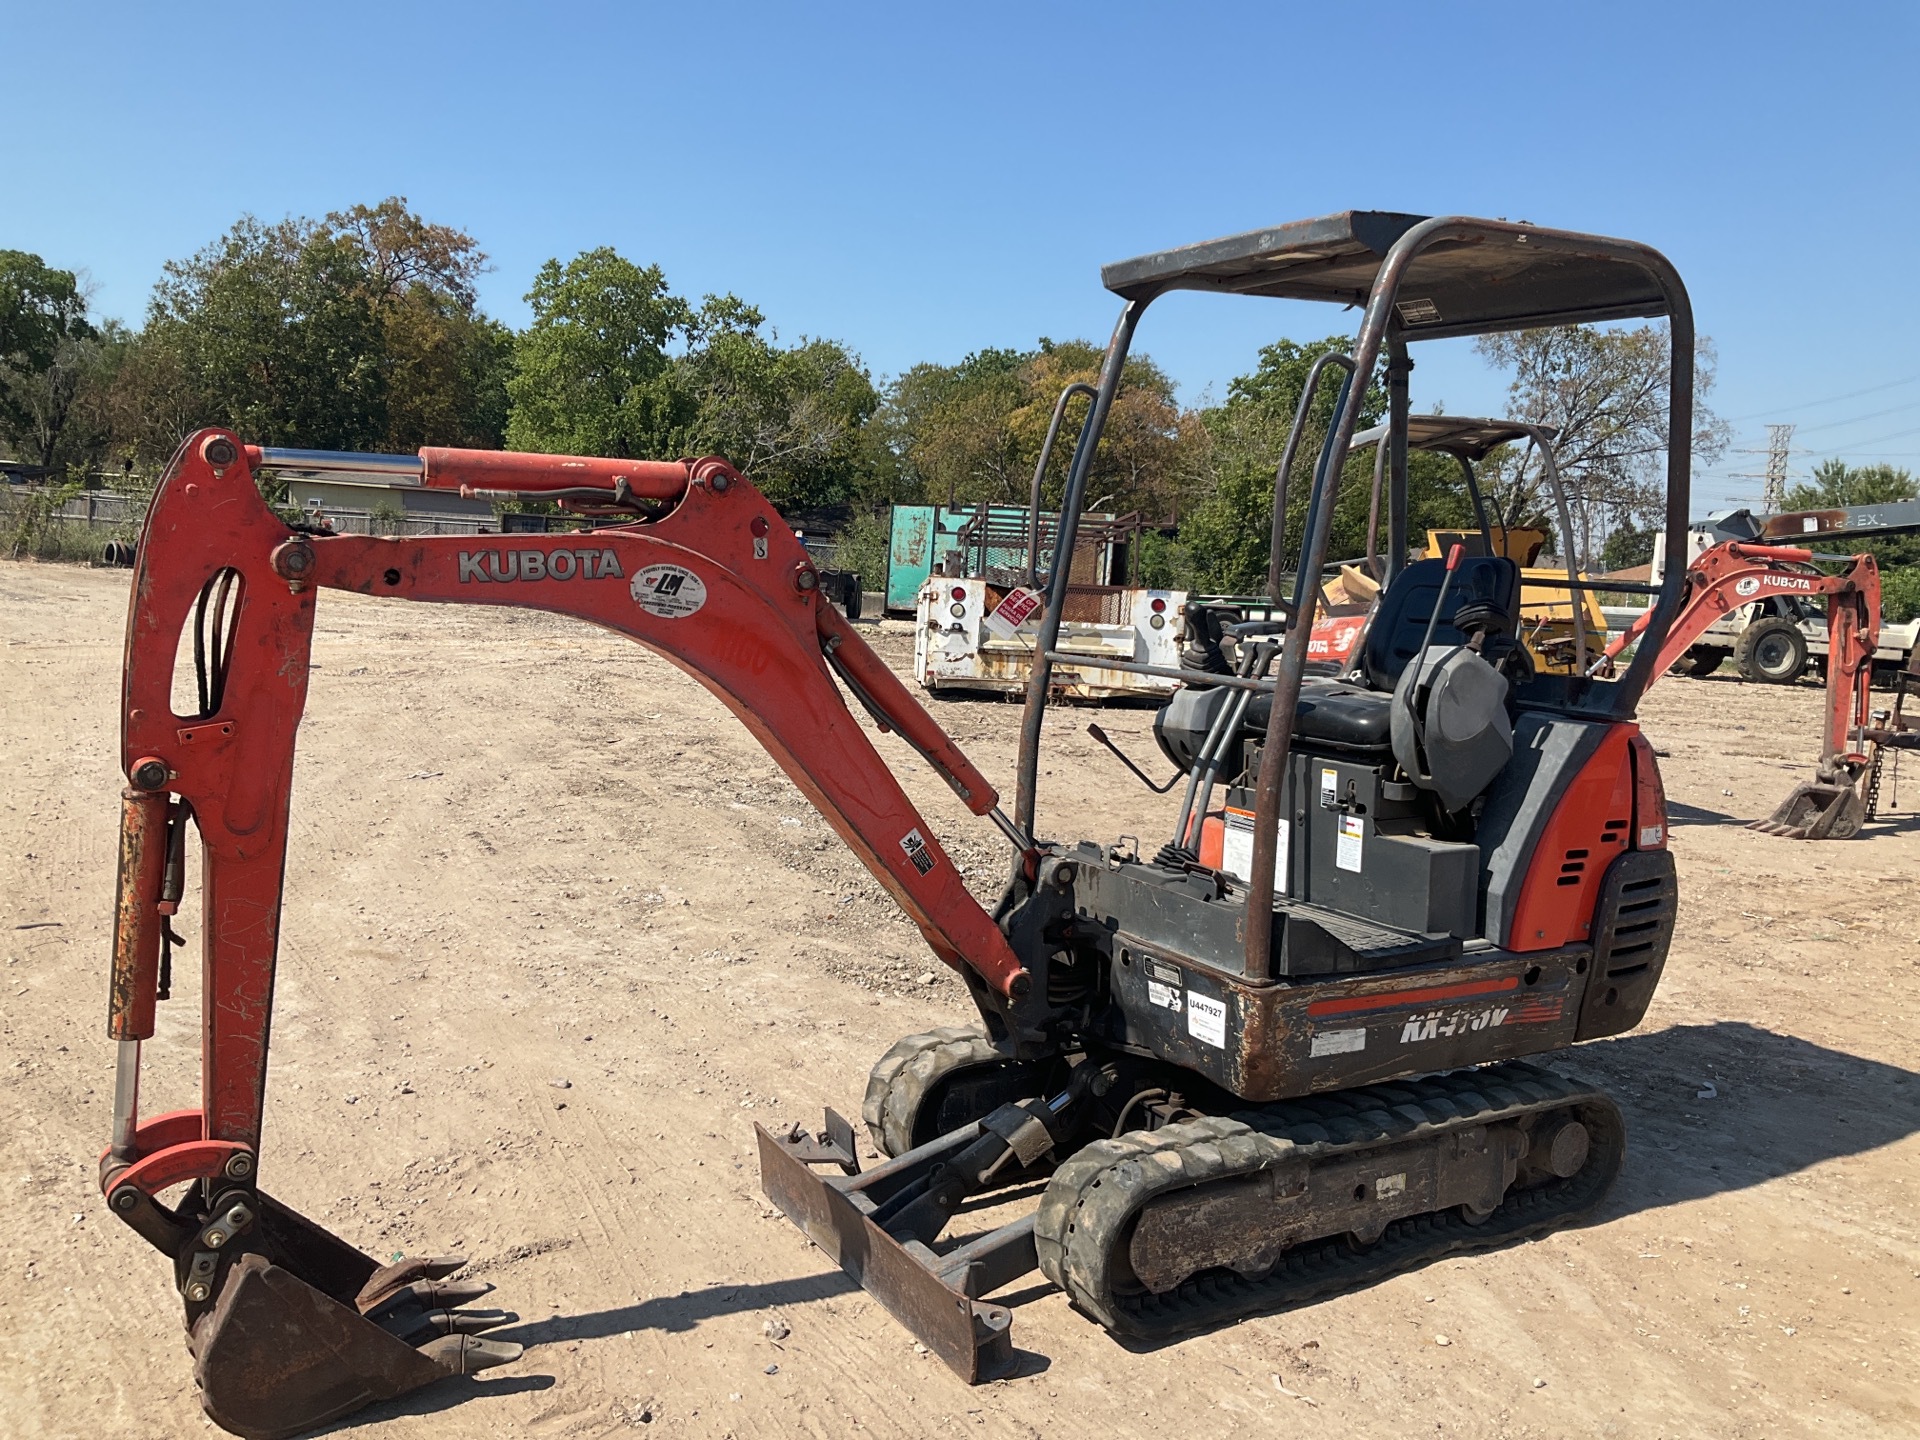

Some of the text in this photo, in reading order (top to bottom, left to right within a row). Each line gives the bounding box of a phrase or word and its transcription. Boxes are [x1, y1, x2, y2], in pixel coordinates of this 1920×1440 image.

[458, 549, 625, 583] KUBOTA
[654, 573, 685, 596] LM
[1763, 575, 1810, 590] KUBOTA
[998, 607, 1019, 625] SERVICIO
[1189, 998, 1222, 1018] U447927
